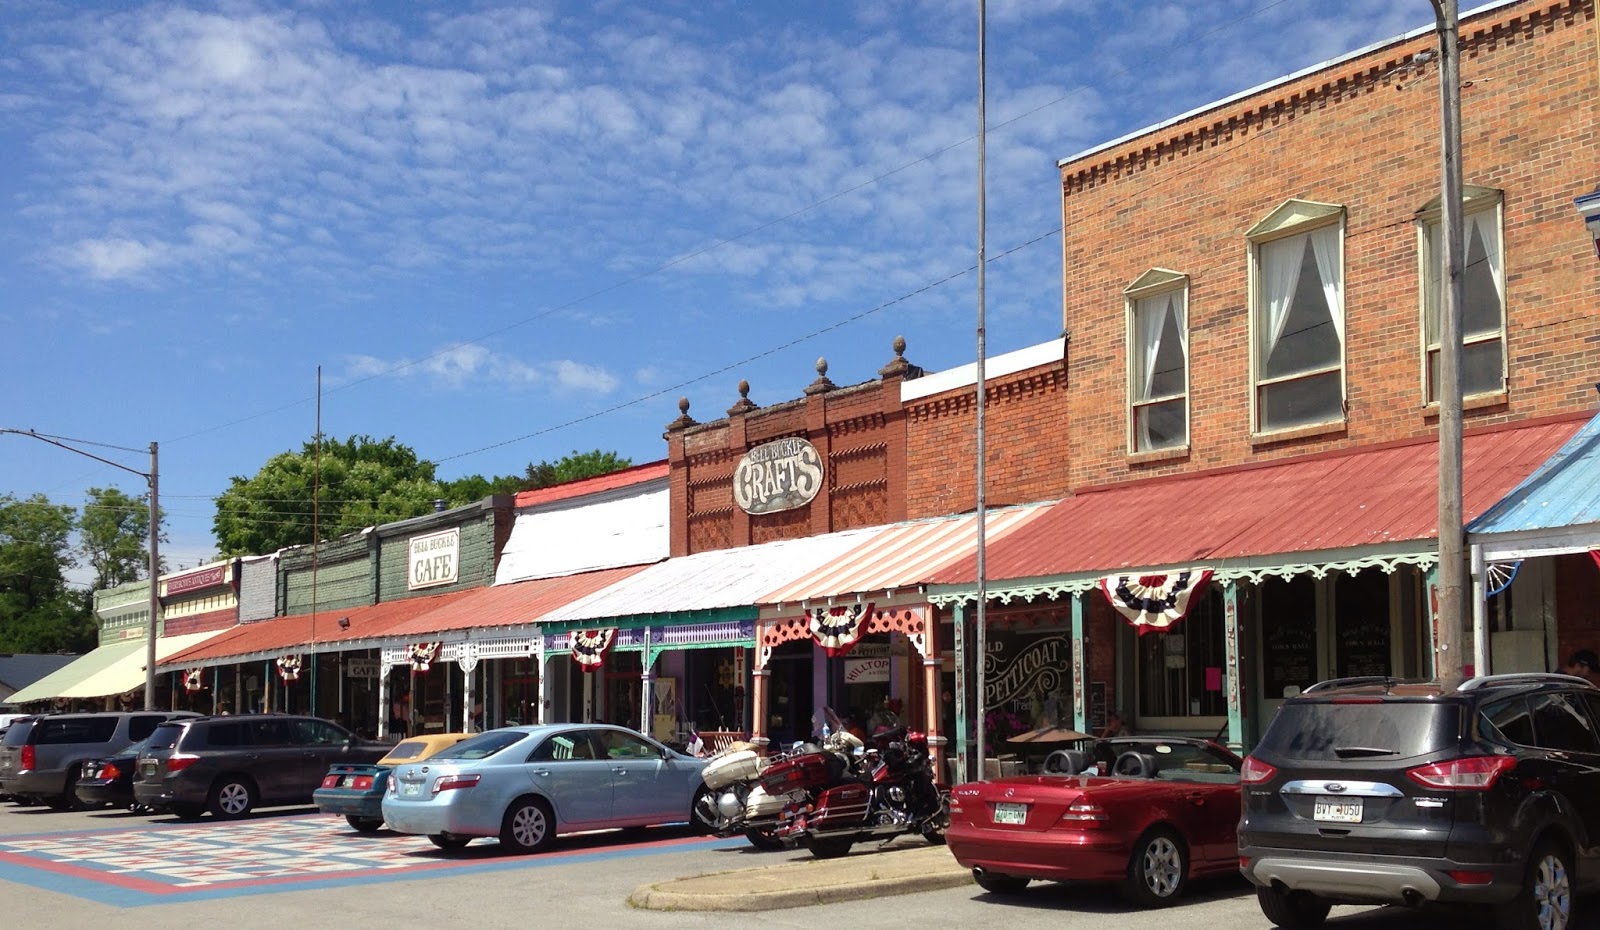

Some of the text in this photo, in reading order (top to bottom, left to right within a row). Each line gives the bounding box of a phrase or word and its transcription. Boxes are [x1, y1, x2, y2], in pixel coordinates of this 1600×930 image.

[751, 439, 802, 463] BELL BUCKLE
[733, 446, 821, 509] CRAFTS
[413, 534, 455, 554] BELL BUCKLE
[414, 553, 452, 583] CAFE
[985, 641, 1004, 653] LD
[352, 666, 379, 676] CAFE
[846, 660, 889, 681] HILLTOP
[985, 640, 1059, 705] PETTICOAT
[1316, 802, 1360, 816] BVY 1050
